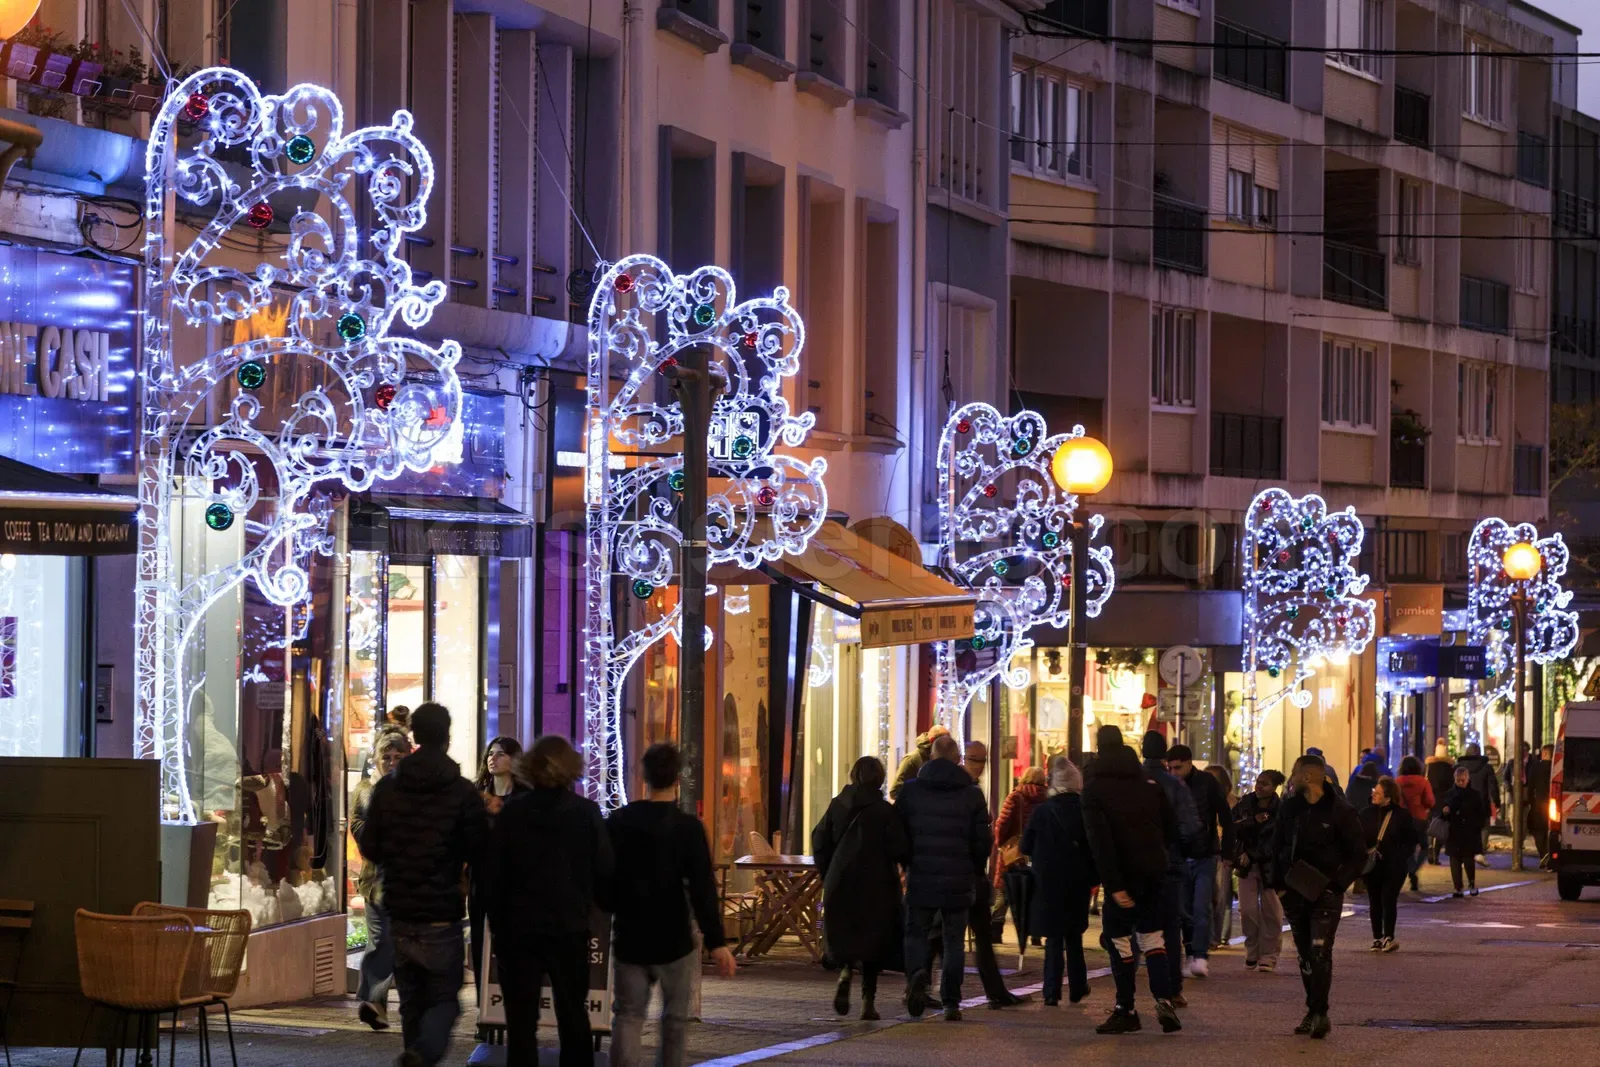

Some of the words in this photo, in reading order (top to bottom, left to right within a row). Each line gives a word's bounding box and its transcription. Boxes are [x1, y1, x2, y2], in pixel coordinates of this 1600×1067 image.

[41, 326, 109, 401] CASH
[4, 520, 32, 541] COFFEE
[37, 521, 51, 541] TEA
[54, 522, 76, 542] ROOM
[78, 523, 93, 542] AND
[96, 523, 130, 542] COMPANY
[1396, 606, 1436, 616] pimkie
